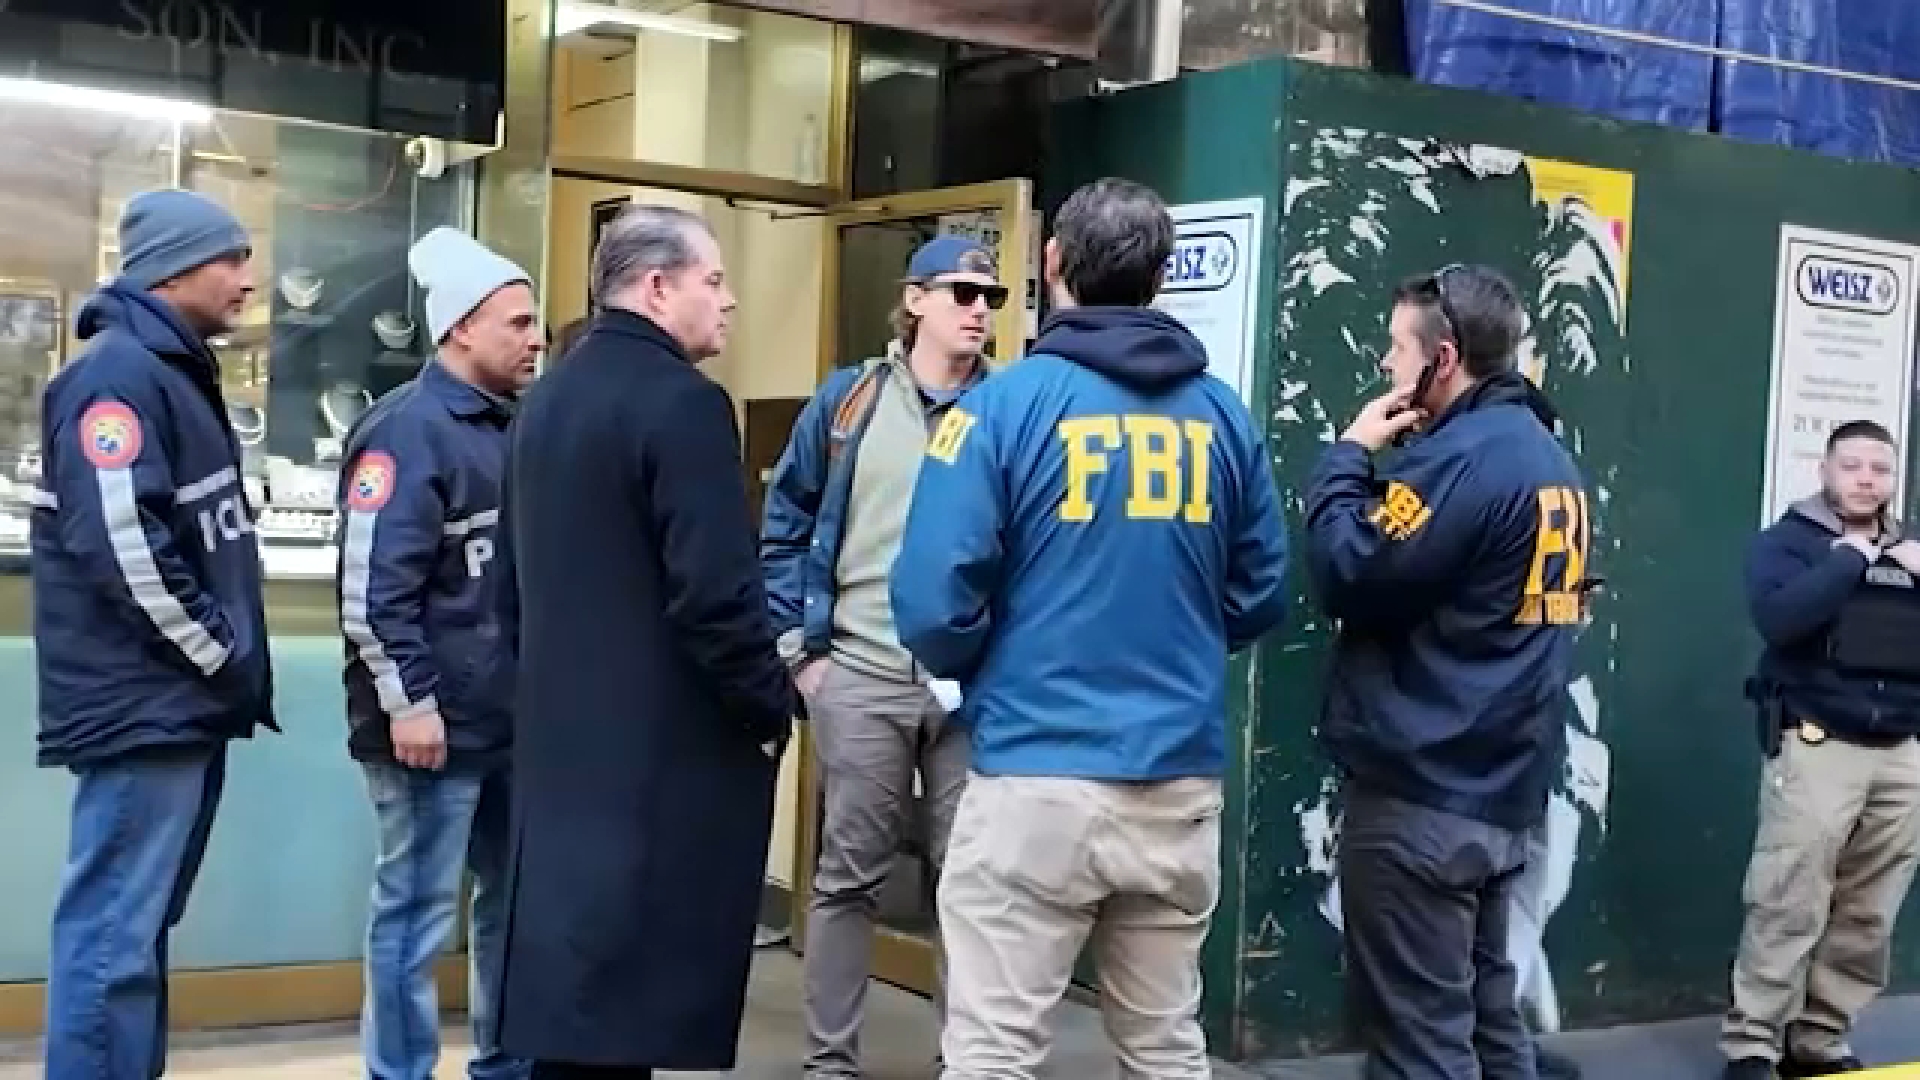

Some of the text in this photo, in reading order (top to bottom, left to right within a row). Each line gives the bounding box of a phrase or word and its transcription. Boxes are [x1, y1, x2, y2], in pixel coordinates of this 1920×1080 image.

[1808, 266, 1873, 304] WEISZ
[927, 407, 977, 465] BI
[1058, 414, 1213, 522] FBI
